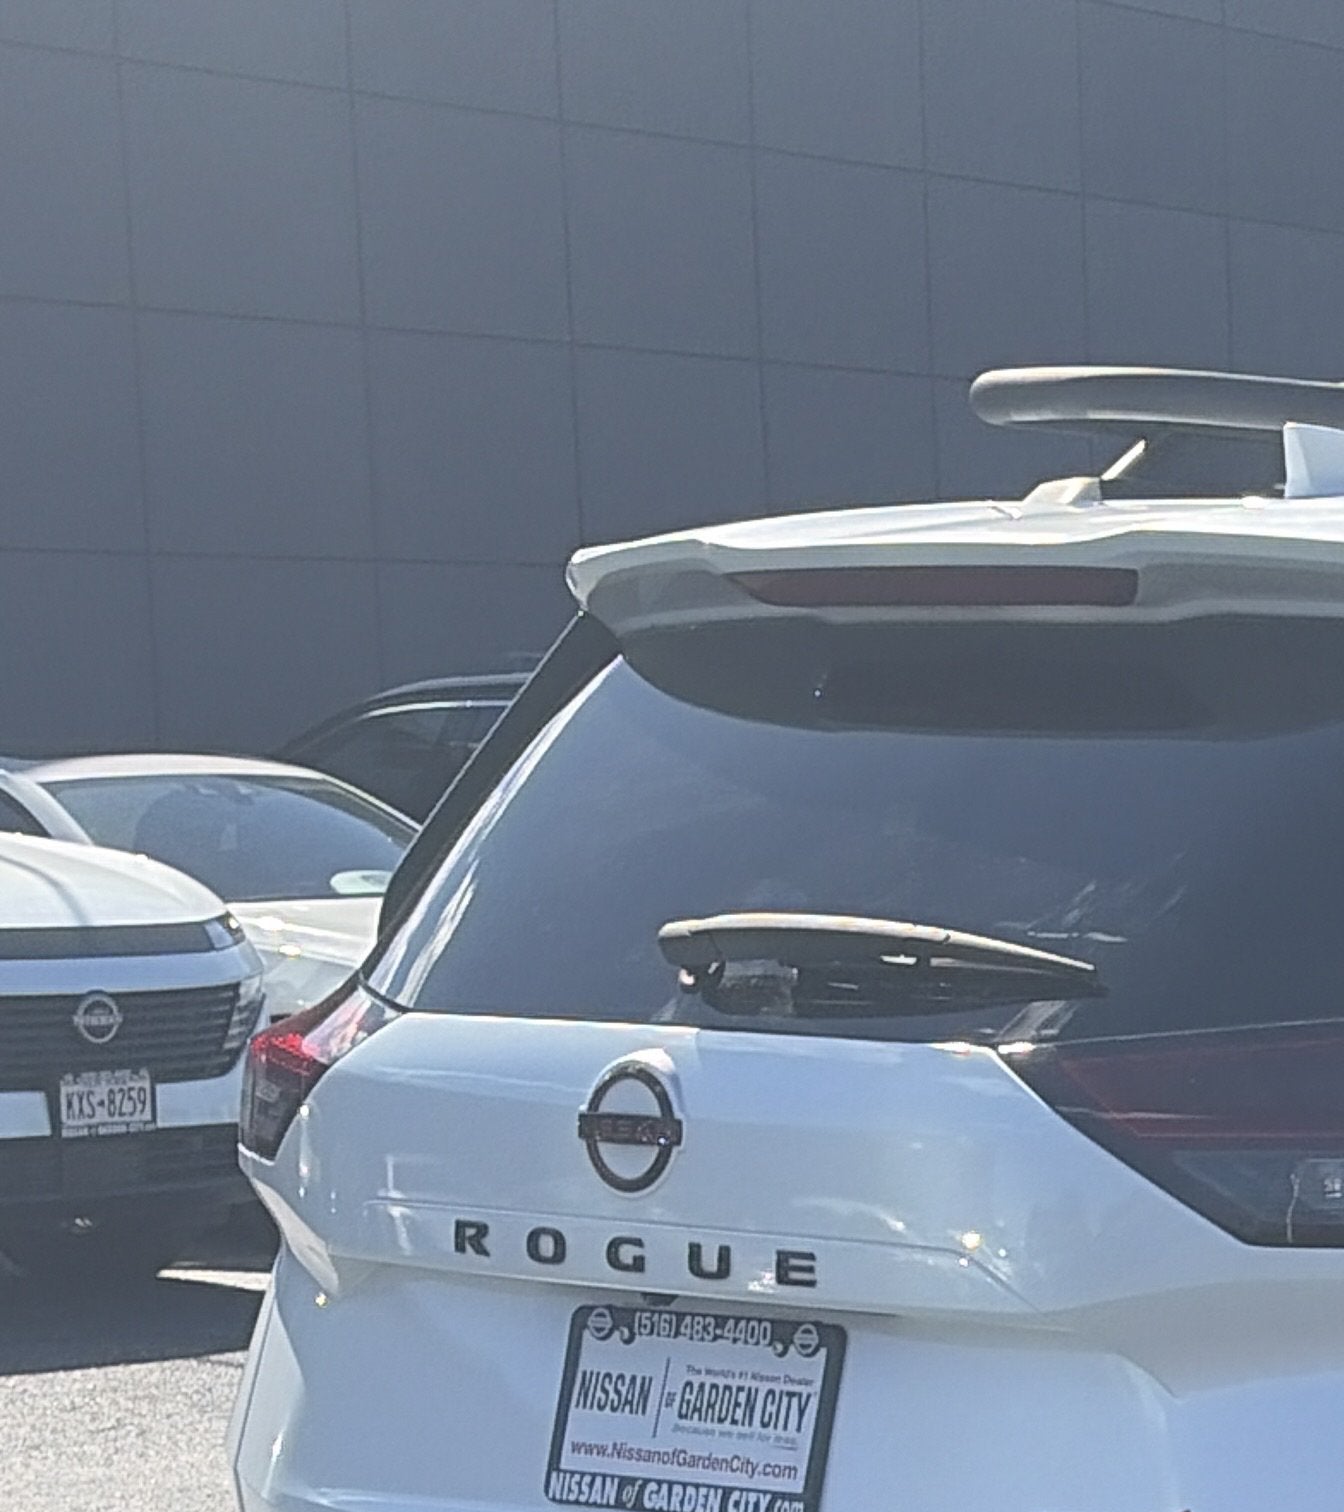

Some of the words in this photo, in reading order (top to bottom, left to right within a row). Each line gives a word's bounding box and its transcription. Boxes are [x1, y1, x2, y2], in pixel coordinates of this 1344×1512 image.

[454, 1219, 818, 1288] ROGUE
[634, 1311, 677, 1339] (516)
[680, 1314, 772, 1346] 483-4400
[575, 1369, 652, 1416] NISSAN
[677, 1380, 759, 1428] GARDEN
[760, 1388, 812, 1433] CITY
[571, 1440, 799, 1480] www.NissanofGardenCity.com
[549, 1471, 619, 1506] NISSAN
[622, 1480, 643, 1509] of
